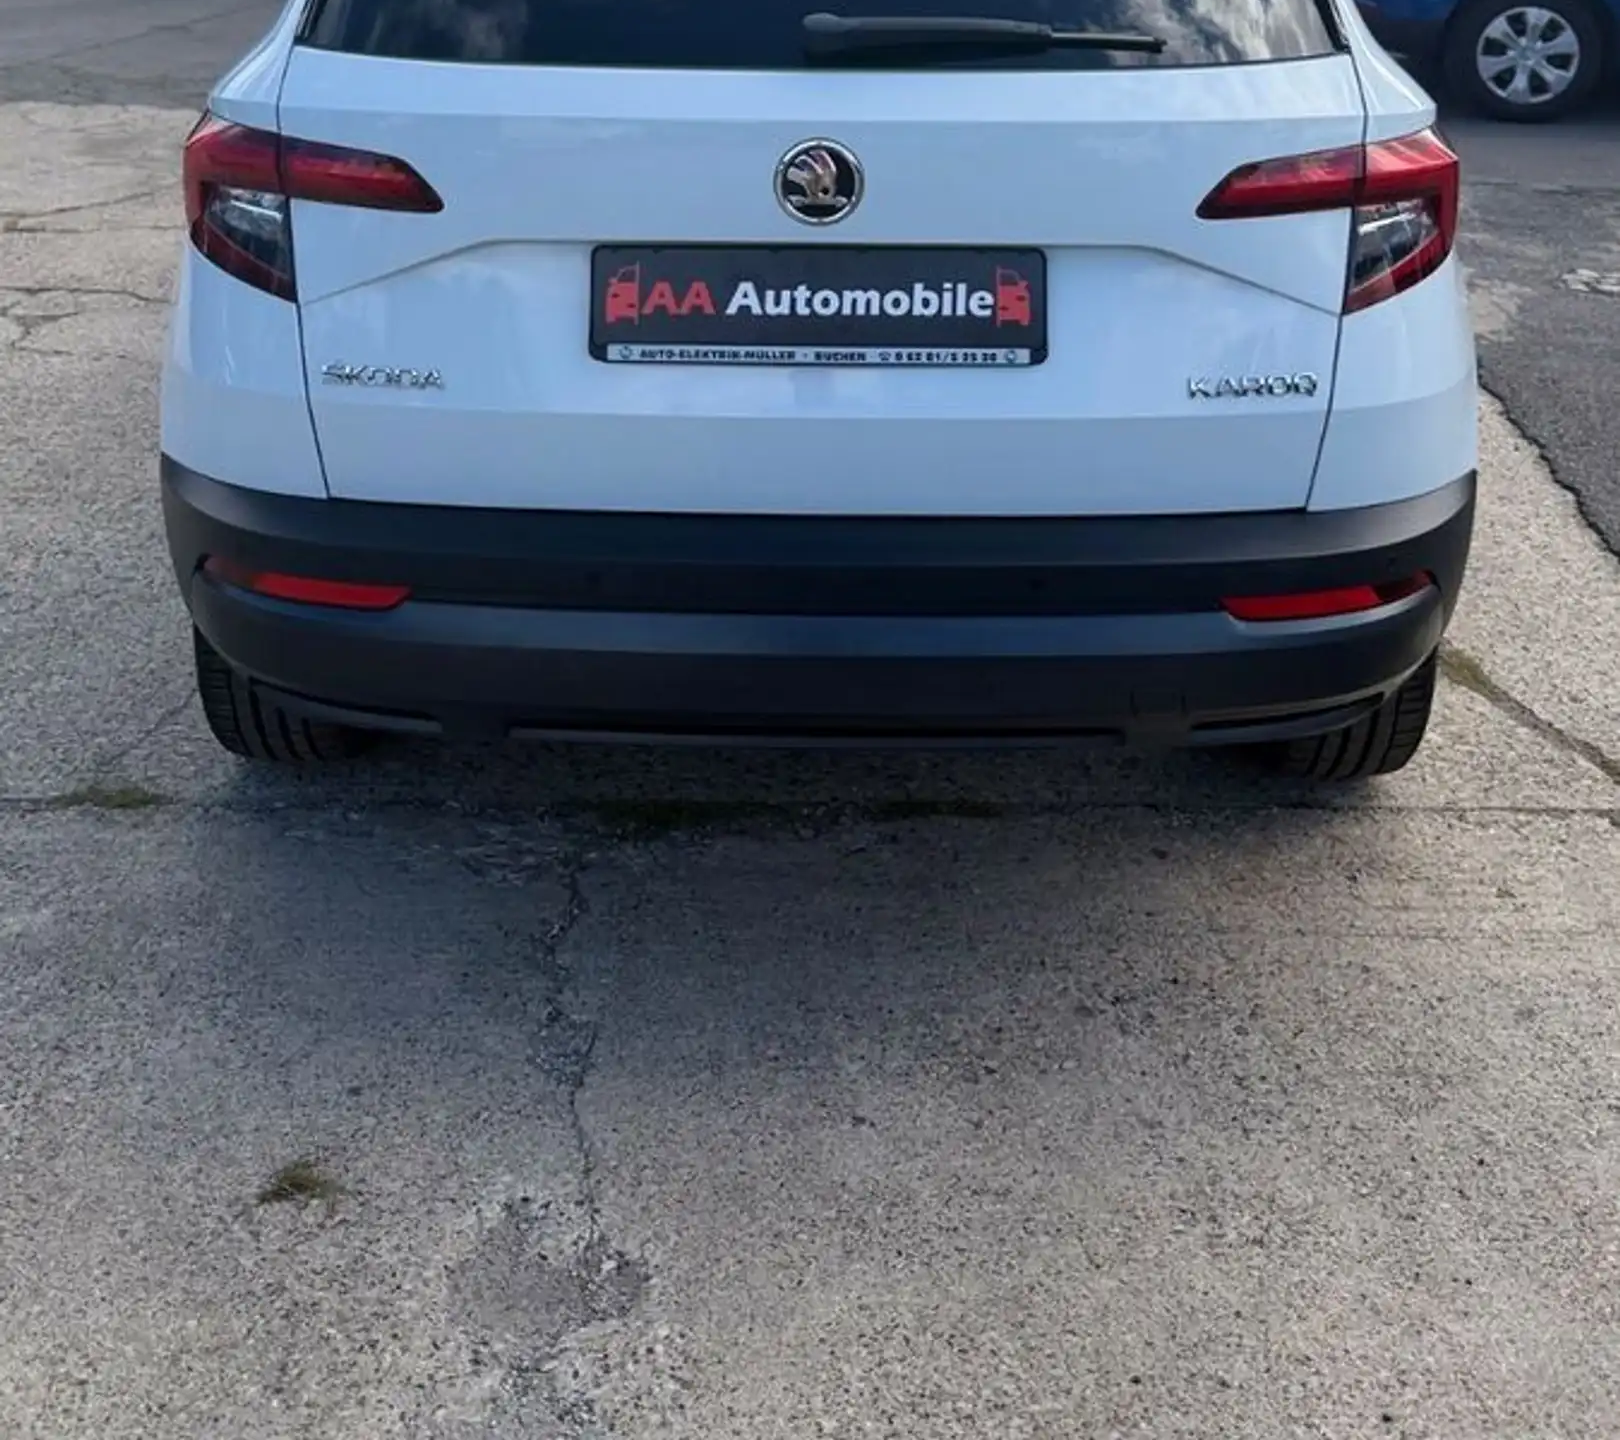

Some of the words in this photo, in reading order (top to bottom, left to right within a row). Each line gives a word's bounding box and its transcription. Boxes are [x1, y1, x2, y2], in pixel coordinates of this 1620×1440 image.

[641, 281, 716, 316] AA
[725, 280, 995, 317] Automobile
[1187, 371, 1318, 399] KAROQ
